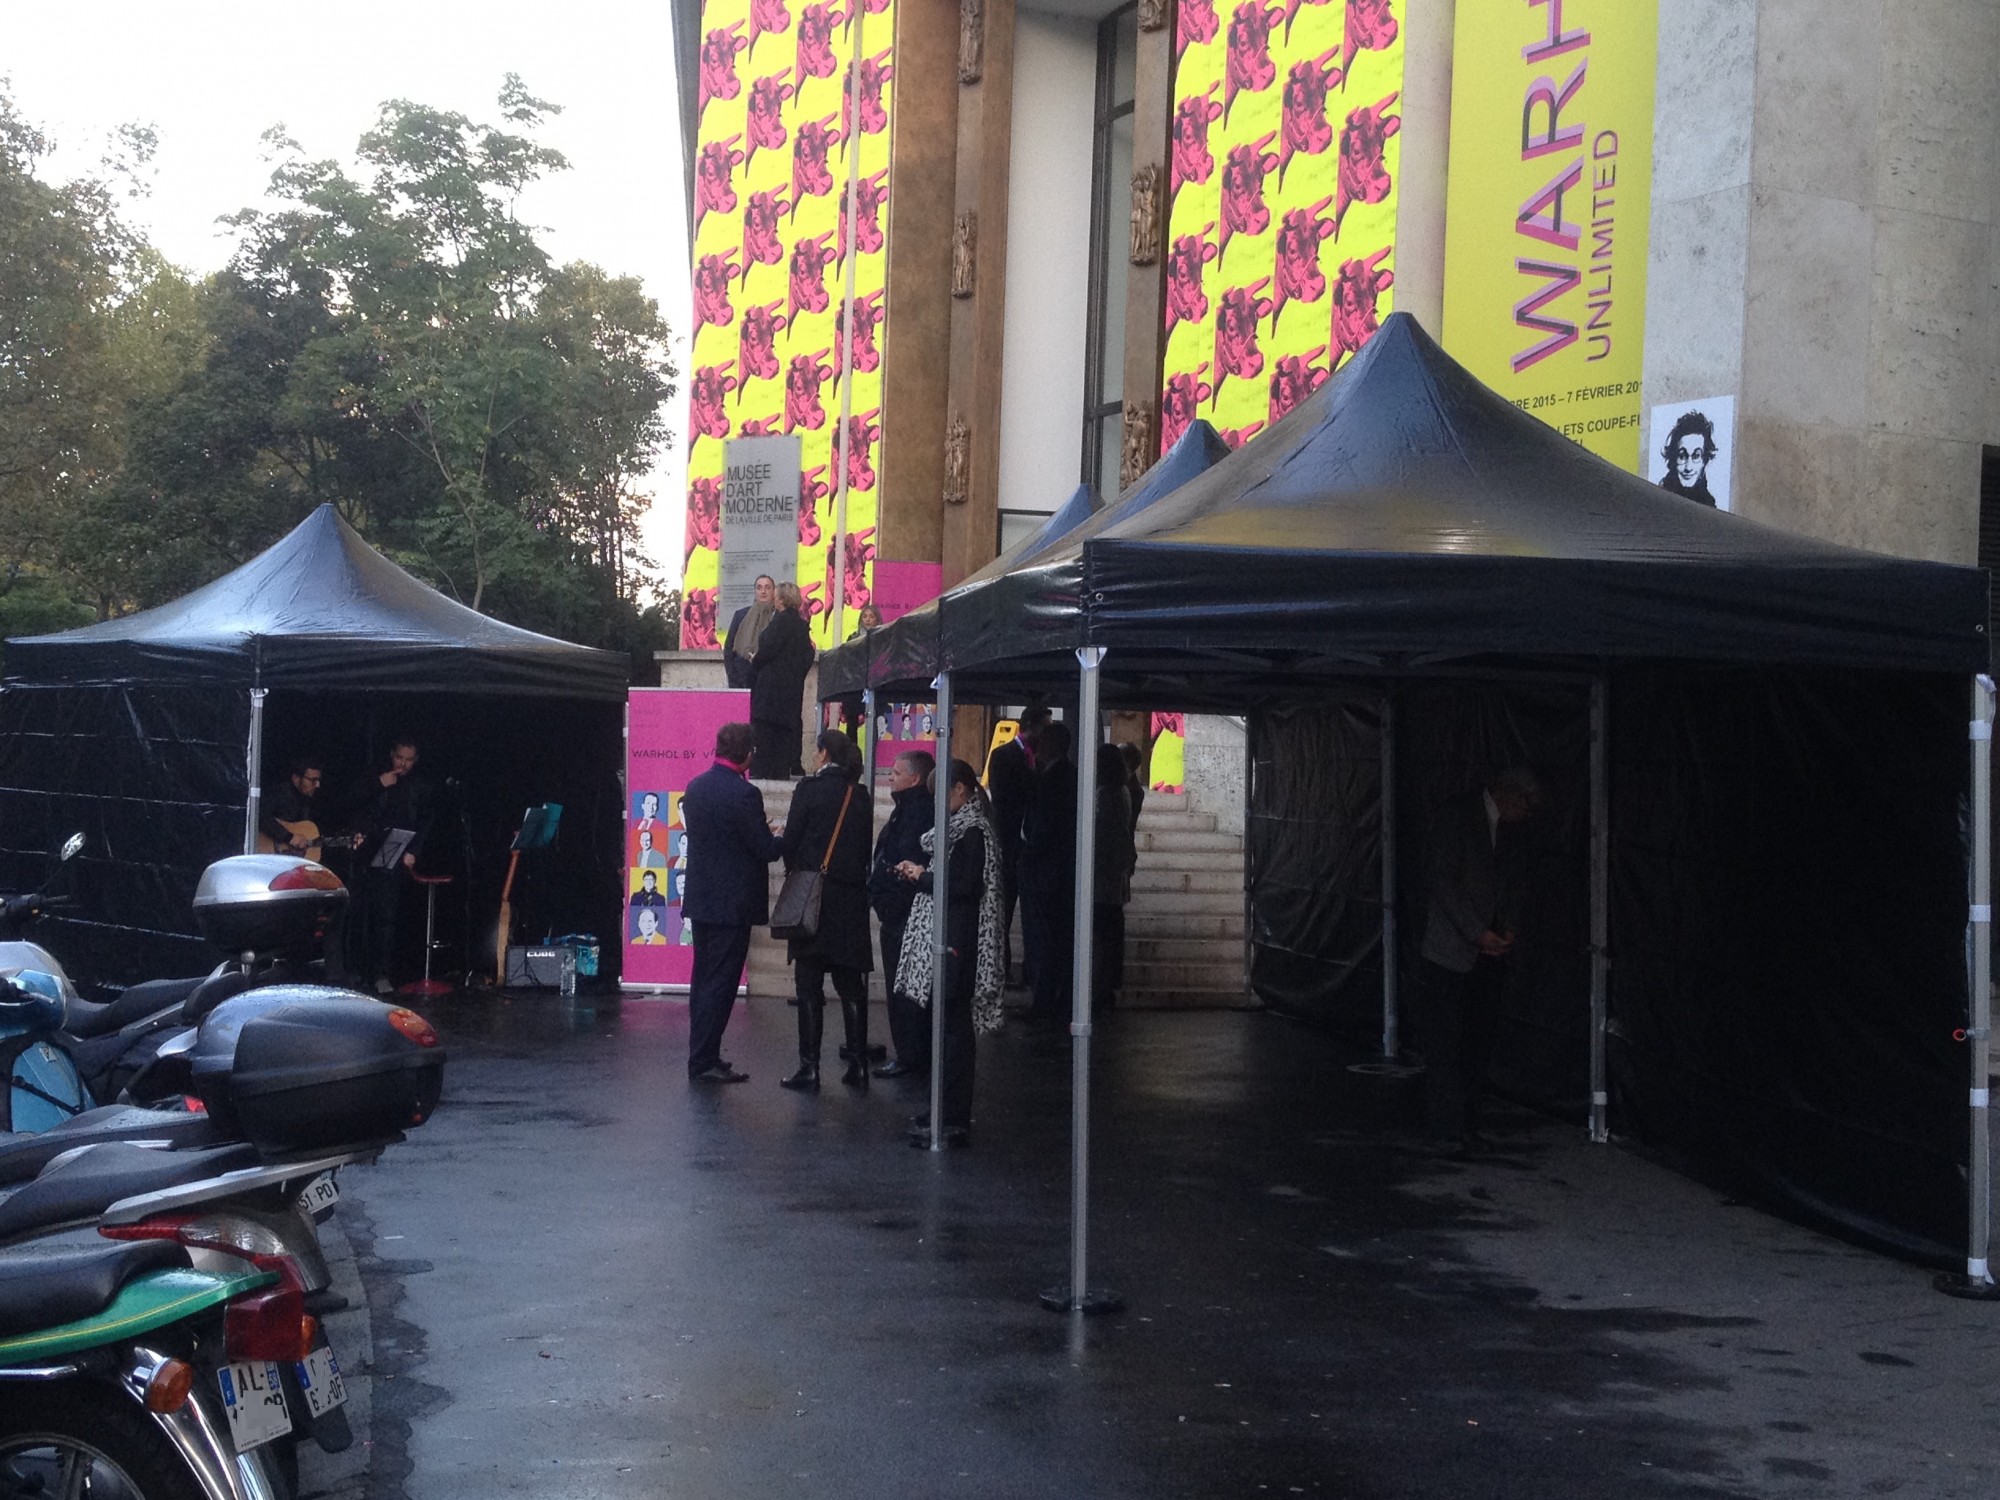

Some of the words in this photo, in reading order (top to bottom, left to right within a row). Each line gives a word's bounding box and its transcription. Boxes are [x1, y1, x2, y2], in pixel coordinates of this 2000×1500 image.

[1585, 129, 1619, 363] UNLIMITED
[1532, 393, 1556, 409] 2015
[1567, 391, 1573, 404] 7
[1575, 383, 1623, 402] FÉVRIER
[726, 481, 763, 498] D'ART
[725, 495, 793, 514] MODERNE
[774, 513, 793, 522] PARIS
[632, 749, 680, 759] WARHOL
[683, 750, 697, 759] BY
